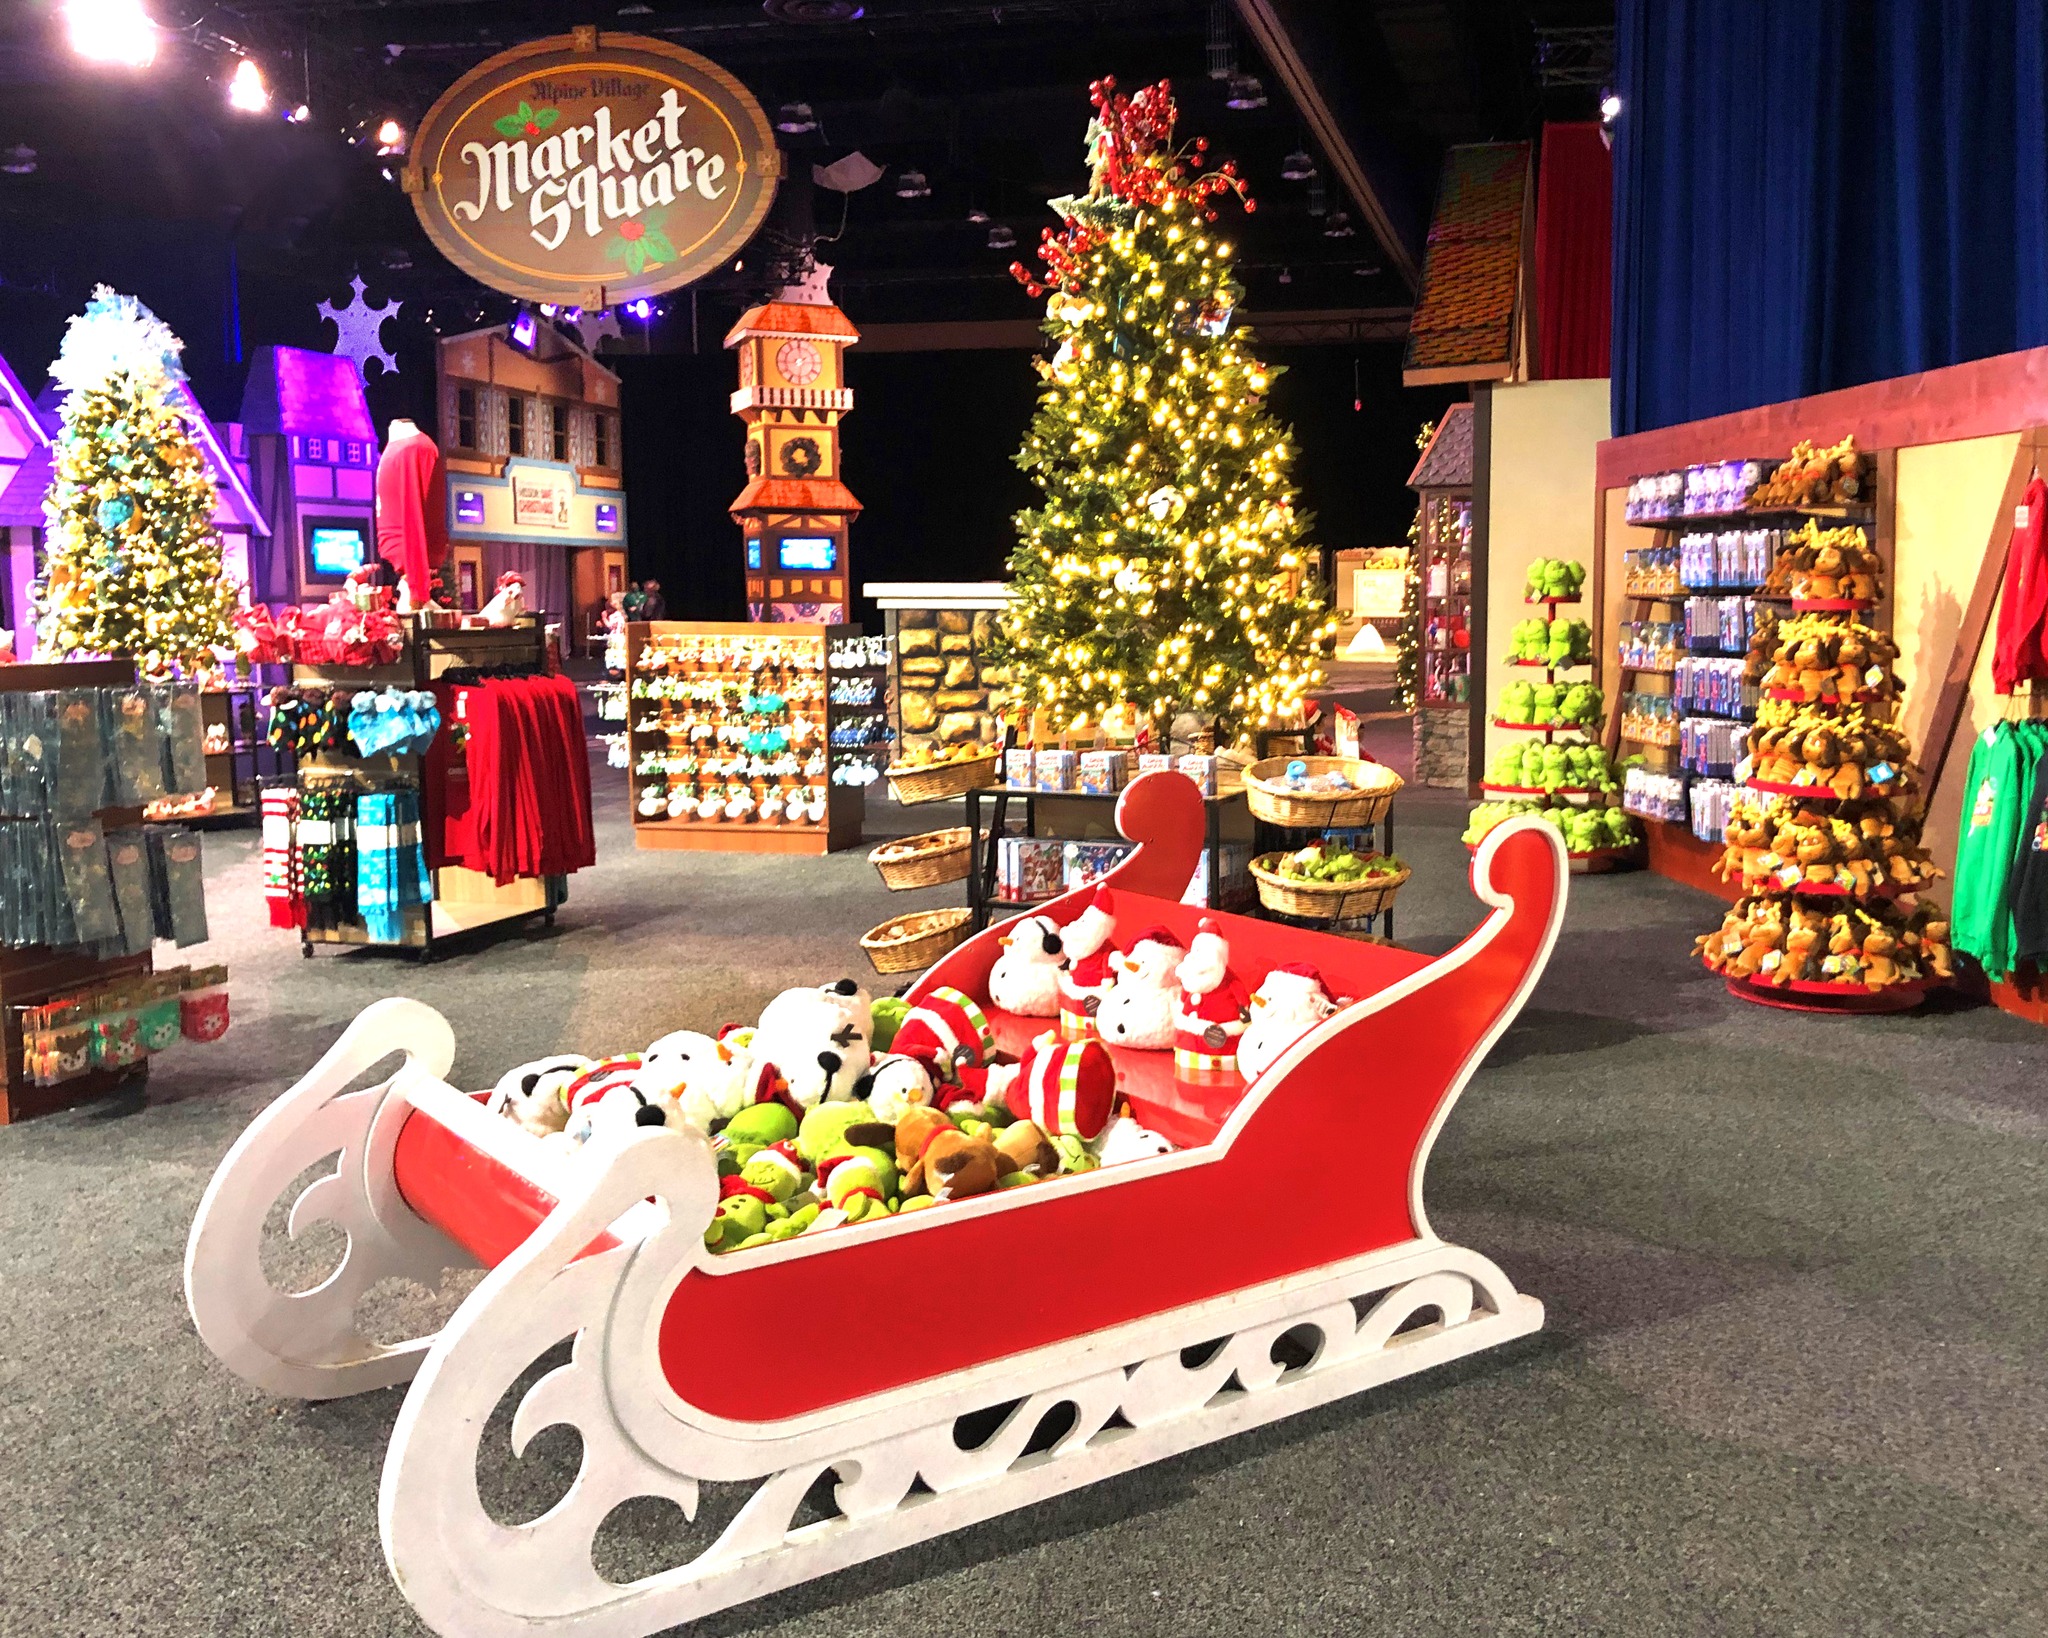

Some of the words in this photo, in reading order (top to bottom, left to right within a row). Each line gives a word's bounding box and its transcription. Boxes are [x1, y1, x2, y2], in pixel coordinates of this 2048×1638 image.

[530, 79, 587, 104] Alpine
[590, 77, 651, 102] Village
[453, 88, 687, 222] Market
